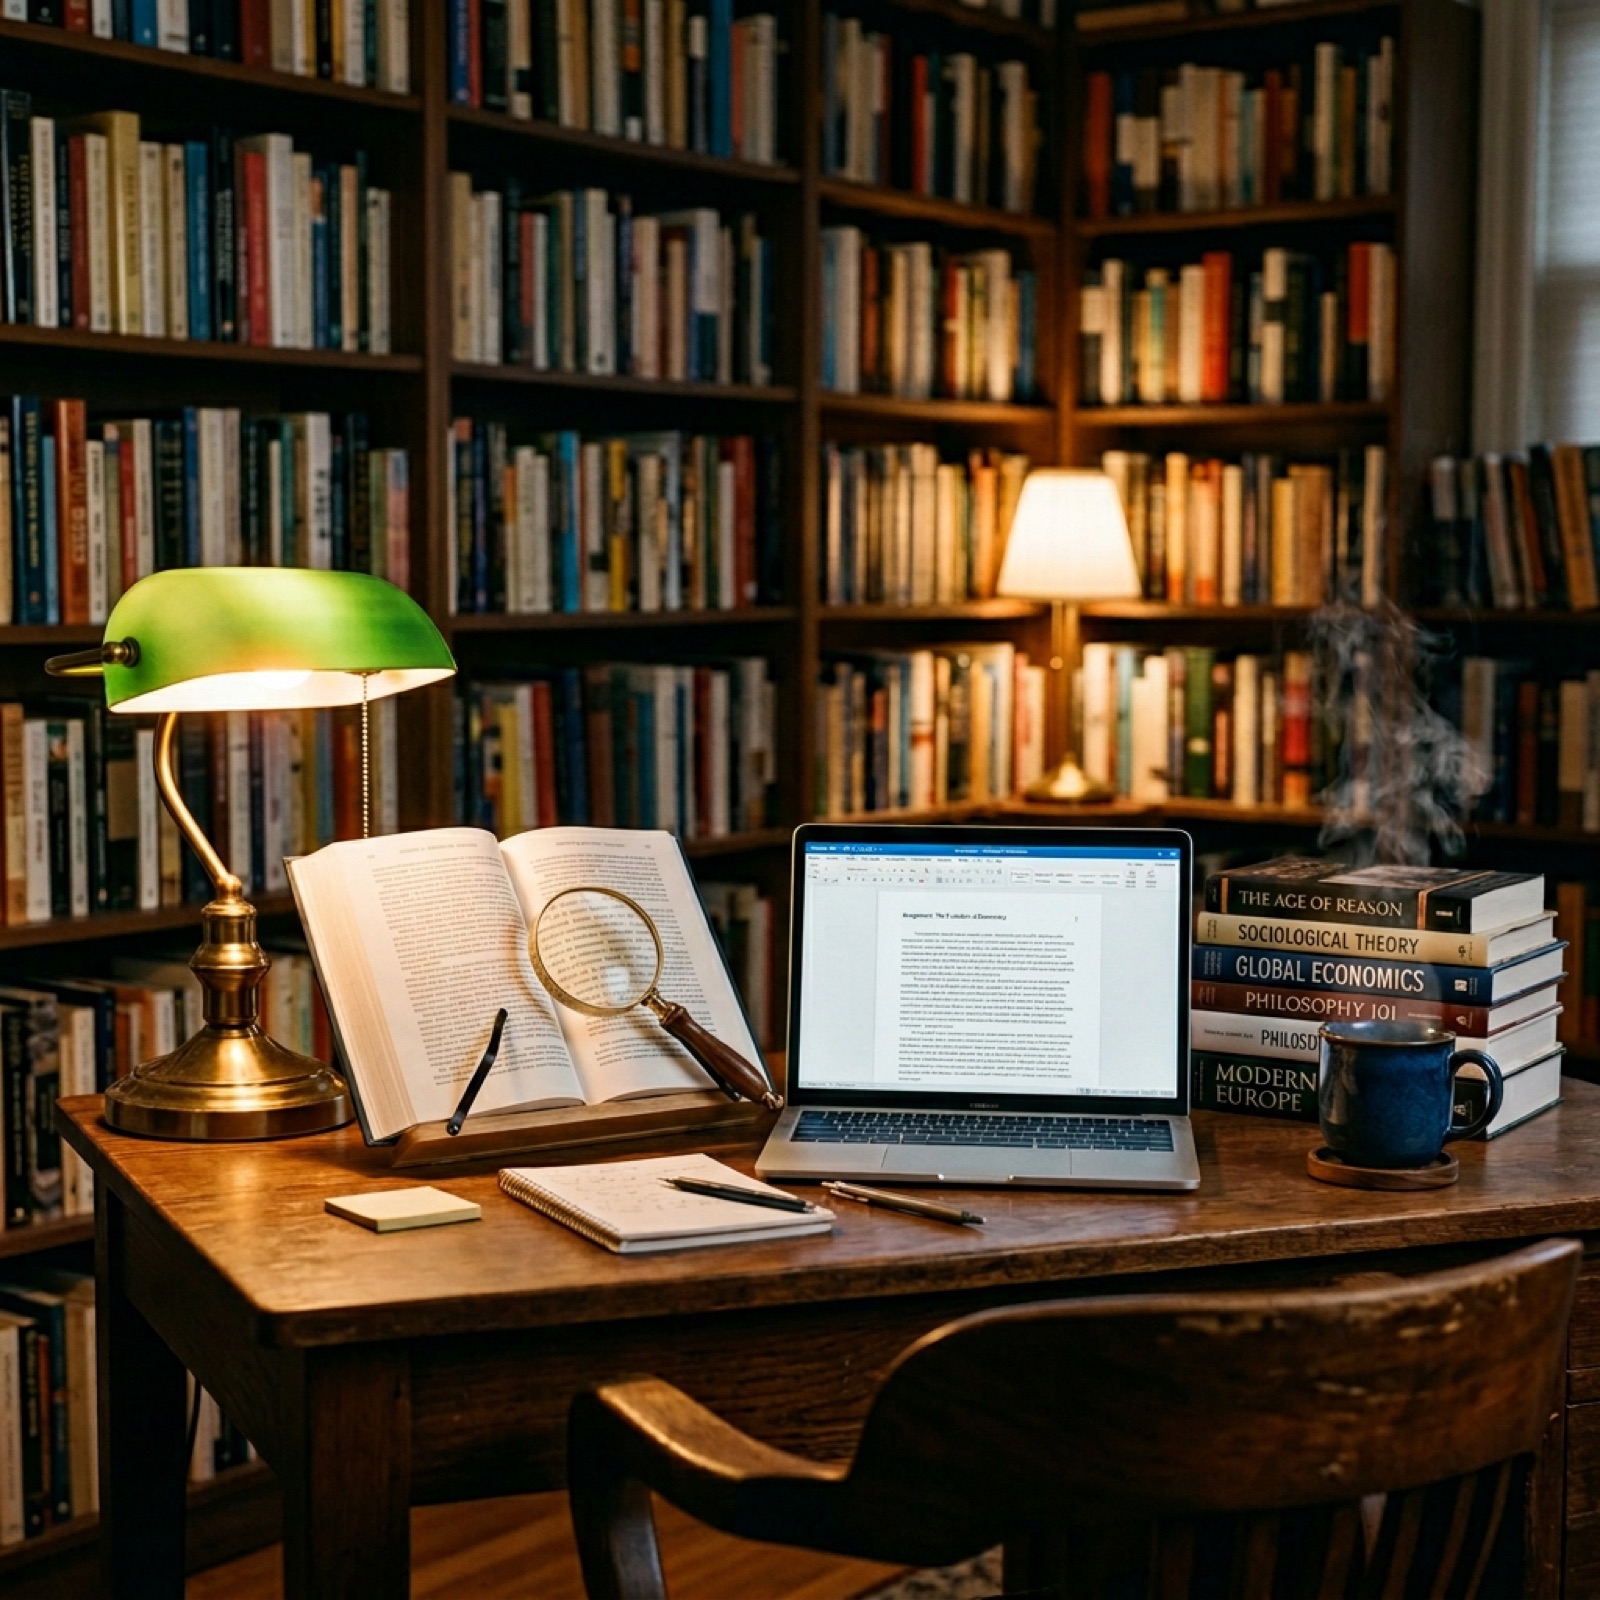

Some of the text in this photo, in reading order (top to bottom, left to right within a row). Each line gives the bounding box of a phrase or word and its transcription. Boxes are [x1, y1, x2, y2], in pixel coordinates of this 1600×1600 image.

[1238, 890, 1403, 917] THE AGE OF REASON
[1238, 923, 1350, 950] SOCIOLOGICAL
[1355, 933, 1420, 955] THEORY
[1235, 955, 1306, 982] GLOBAL
[1311, 961, 1425, 993] ECONOMICS
[1246, 991, 1397, 1021] PHILOSOPHY 101
[1215, 1063, 1317, 1092] MODERN
[1216, 1084, 1302, 1112] EUROPE
